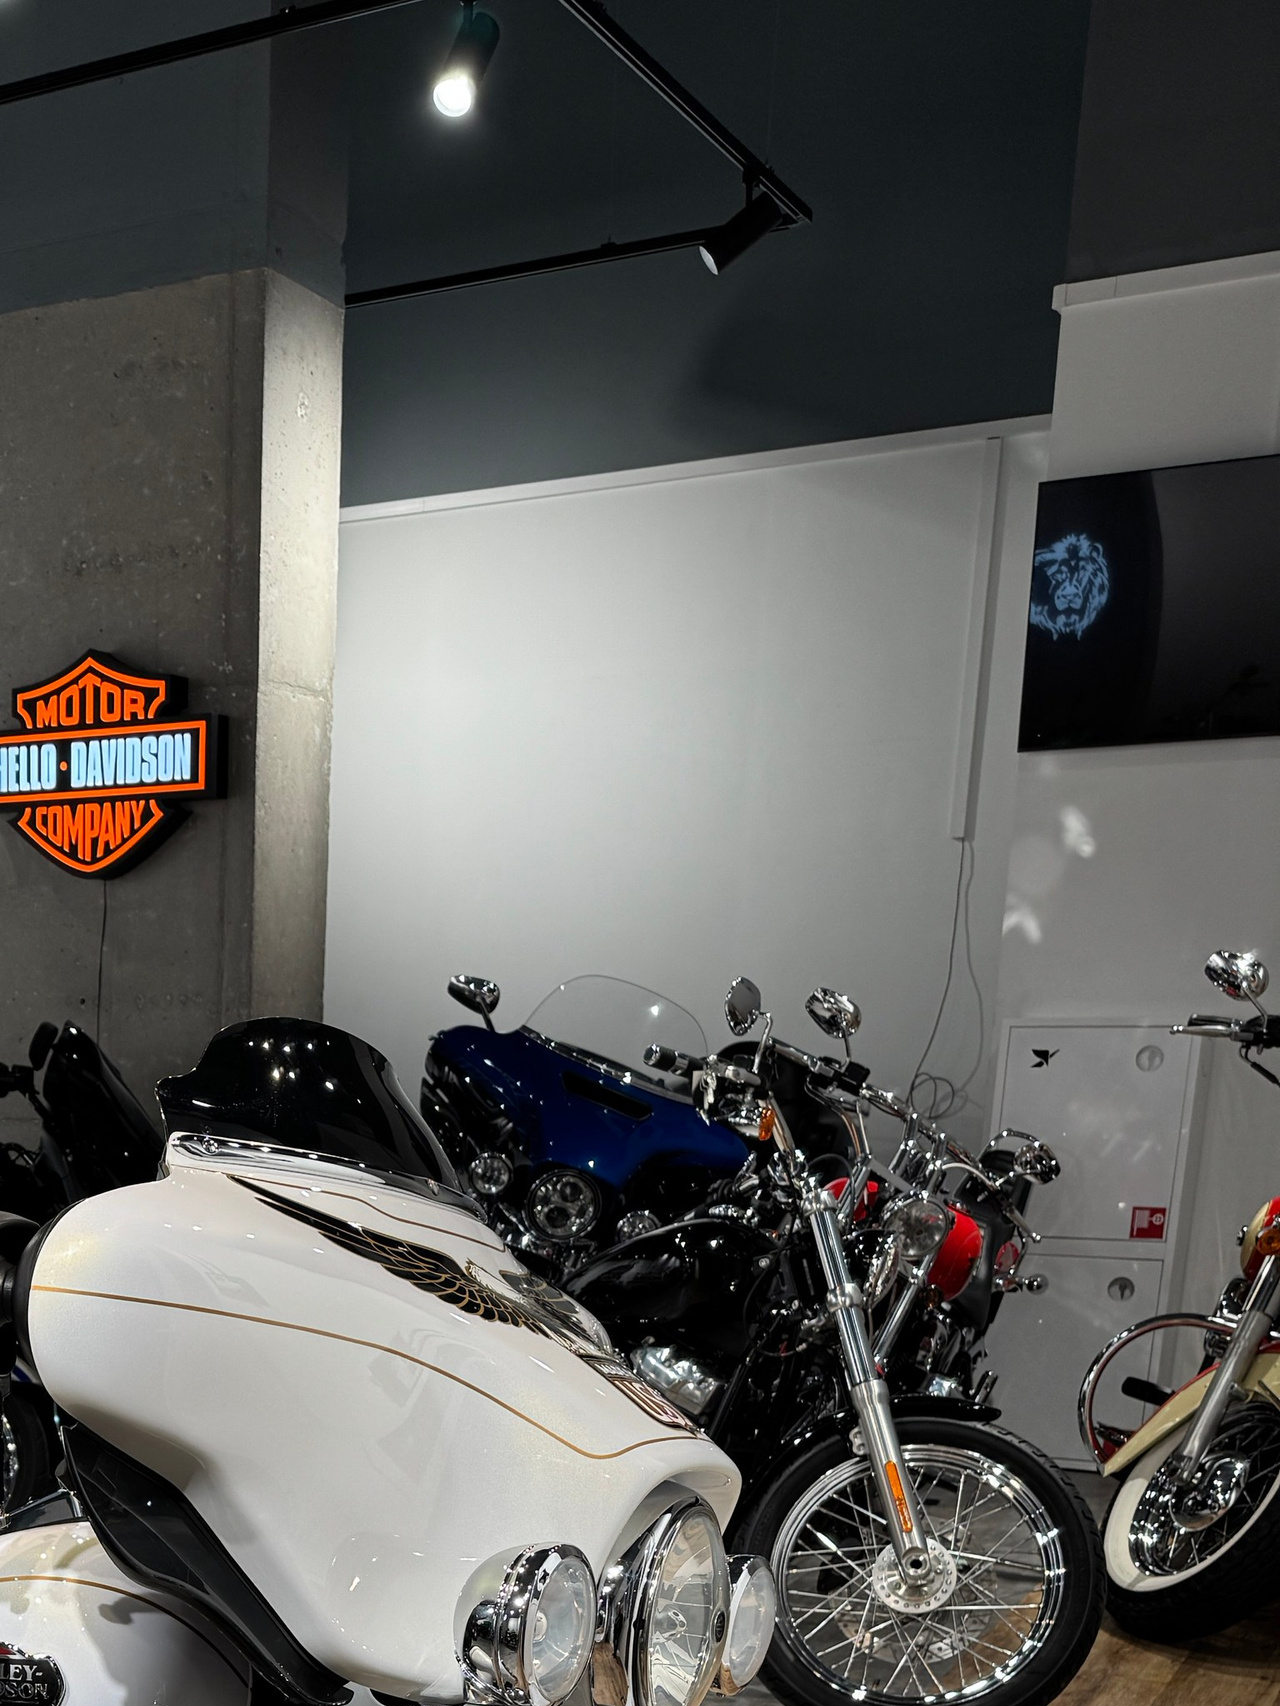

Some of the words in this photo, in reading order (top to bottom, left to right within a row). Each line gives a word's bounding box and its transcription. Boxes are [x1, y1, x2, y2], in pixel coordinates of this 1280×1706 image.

[36, 672, 145, 728] MOTOR
[70, 732, 191, 788] DAVIDSON
[35, 800, 145, 861] COMPANY
